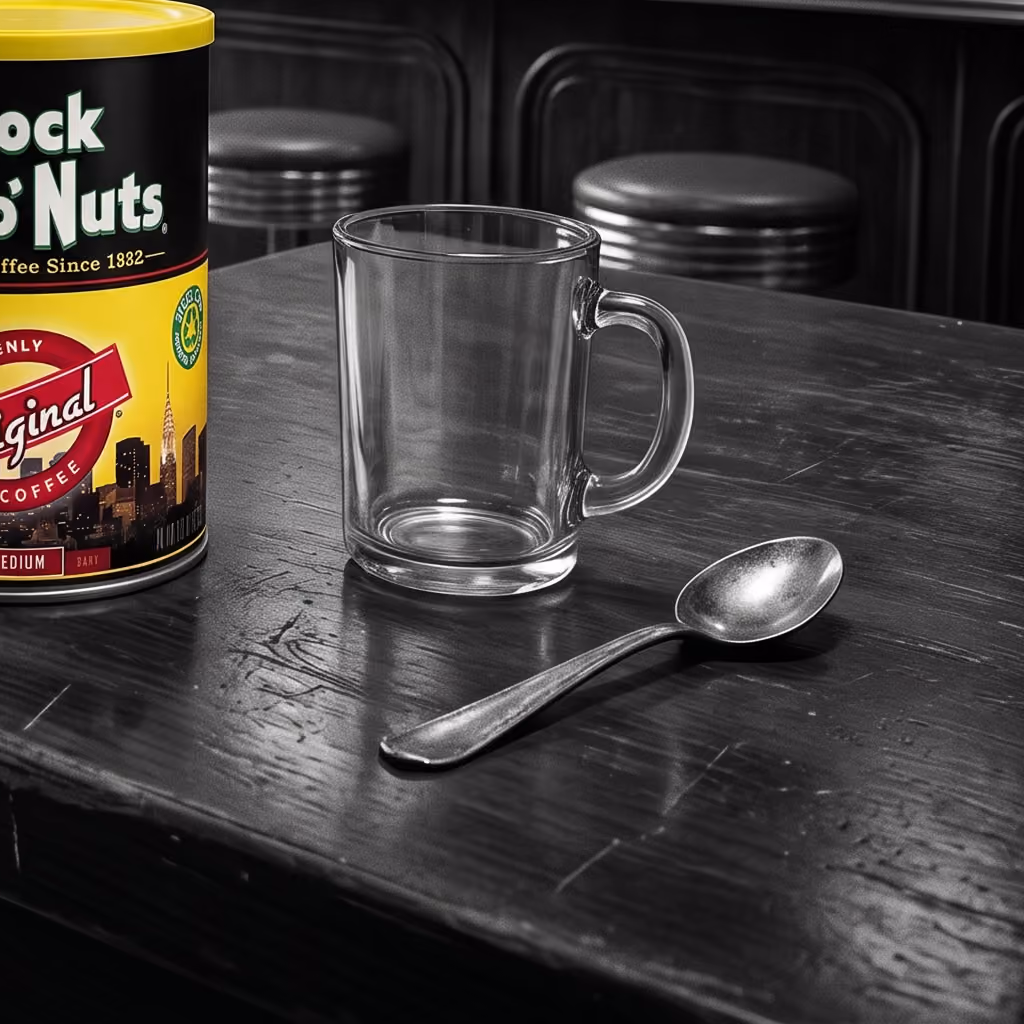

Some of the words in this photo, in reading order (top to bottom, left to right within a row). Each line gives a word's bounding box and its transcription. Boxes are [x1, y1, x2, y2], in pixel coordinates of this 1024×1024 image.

[33, 160, 164, 251] Nuts
[46, 255, 101, 274] Since
[0, 459, 81, 503] COFFEE
